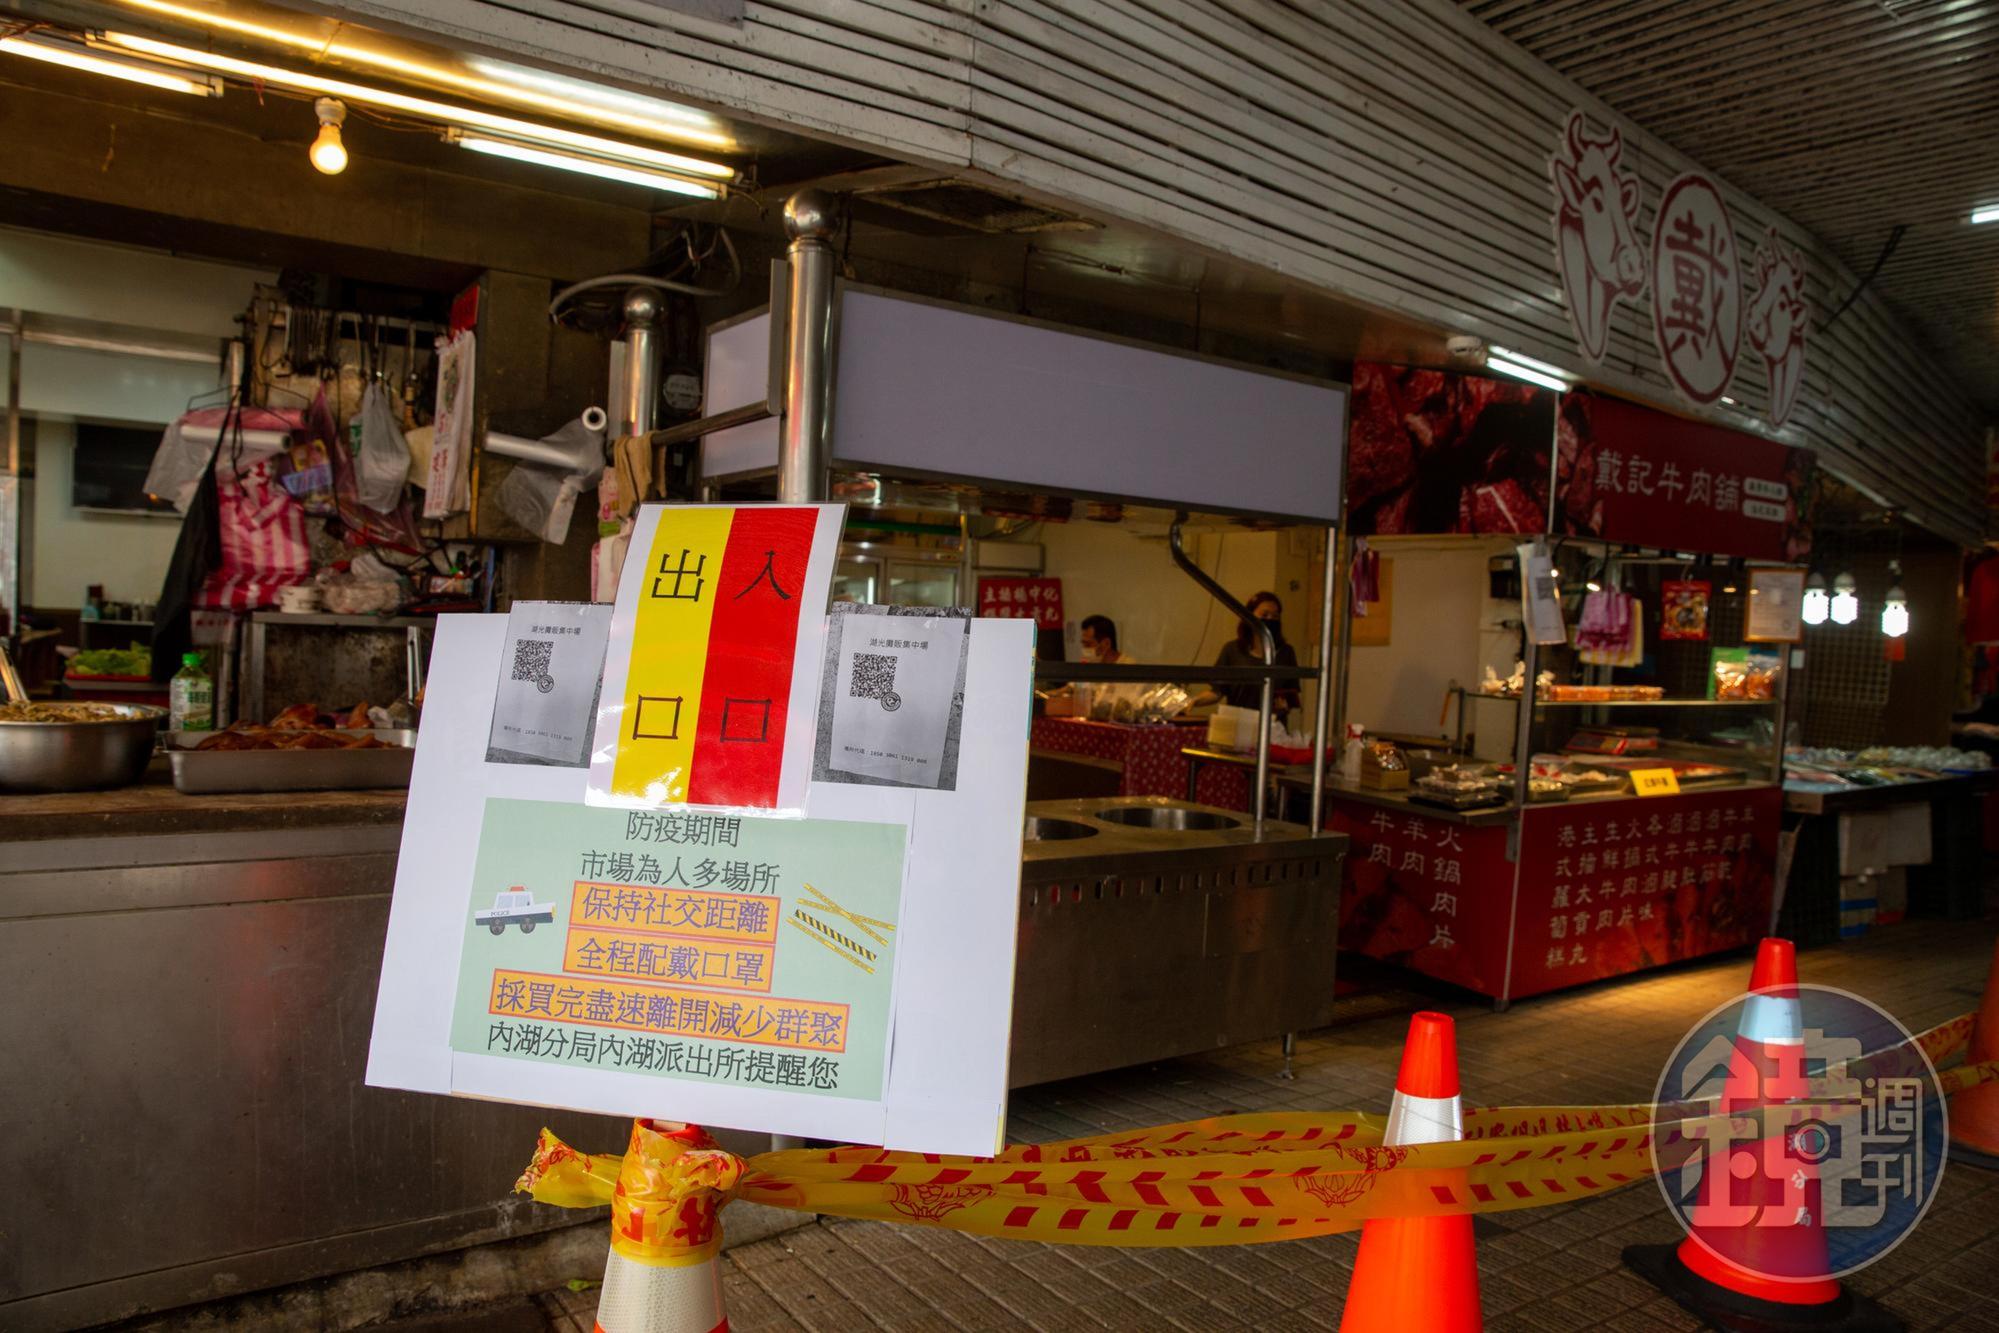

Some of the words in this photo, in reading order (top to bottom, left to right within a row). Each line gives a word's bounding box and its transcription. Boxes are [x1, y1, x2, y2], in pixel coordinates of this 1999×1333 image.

[1665, 208, 1731, 362] 戴
[632, 549, 706, 740] 出口
[719, 549, 792, 743] 入口
[625, 811, 742, 848] 防疫期間
[1367, 810, 1395, 867] 牛肉
[1399, 816, 1429, 876] 羊肉
[580, 849, 781, 895] 市場為人多場所
[1428, 825, 1463, 950] 火鍋肉片
[582, 885, 770, 935] 保持社交距離
[576, 937, 766, 986] 全程配戴口罩
[495, 976, 844, 1047] 採買完盡速離開減少群聚
[487, 1020, 840, 1090] 內湖分局內湖派出所提醒您
